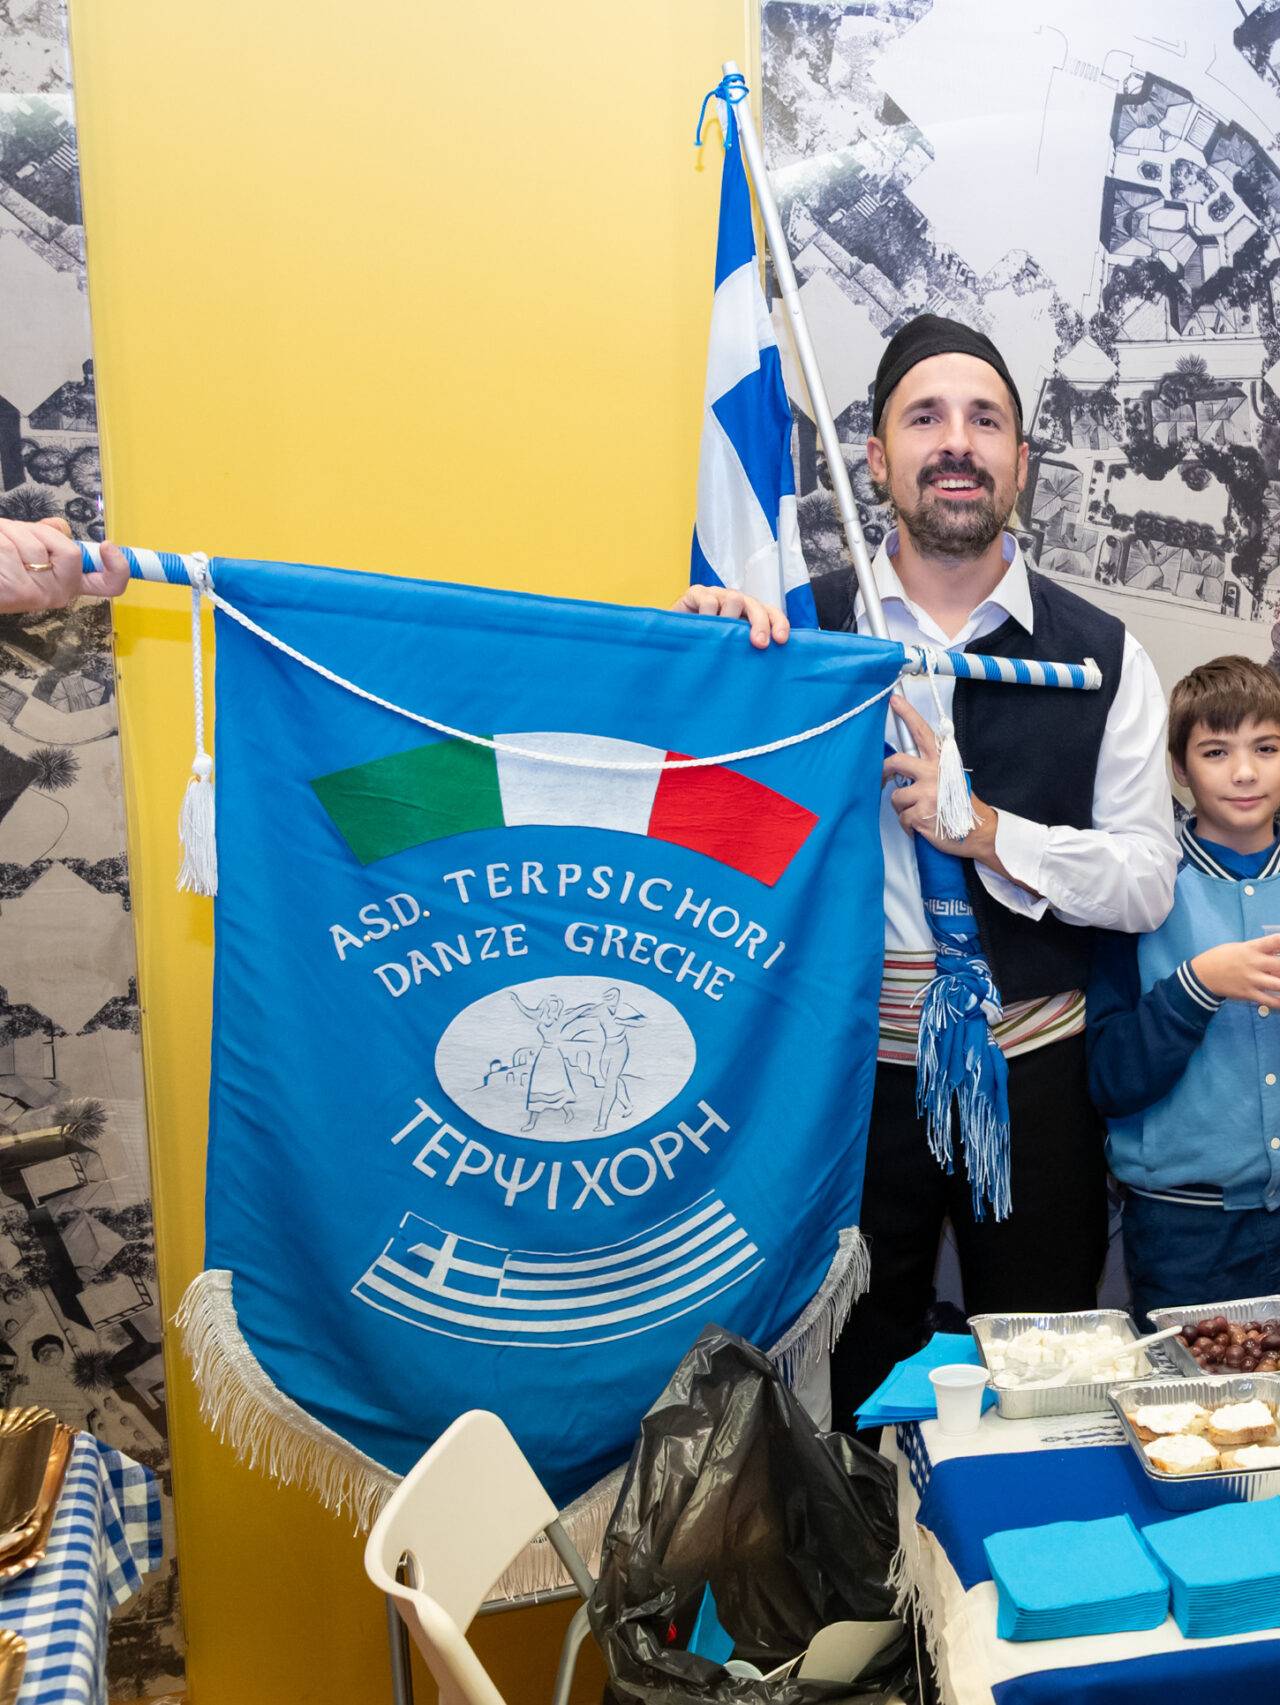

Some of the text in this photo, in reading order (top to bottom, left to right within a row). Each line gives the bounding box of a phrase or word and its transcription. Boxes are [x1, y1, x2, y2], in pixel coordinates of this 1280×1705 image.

[329, 861, 786, 970] A.S.D. TERPSICHORI
[373, 922, 735, 1001] DANZE GRECHE
[390, 1097, 732, 1210] ΤΕΡΨΙΧΟΡΗ
